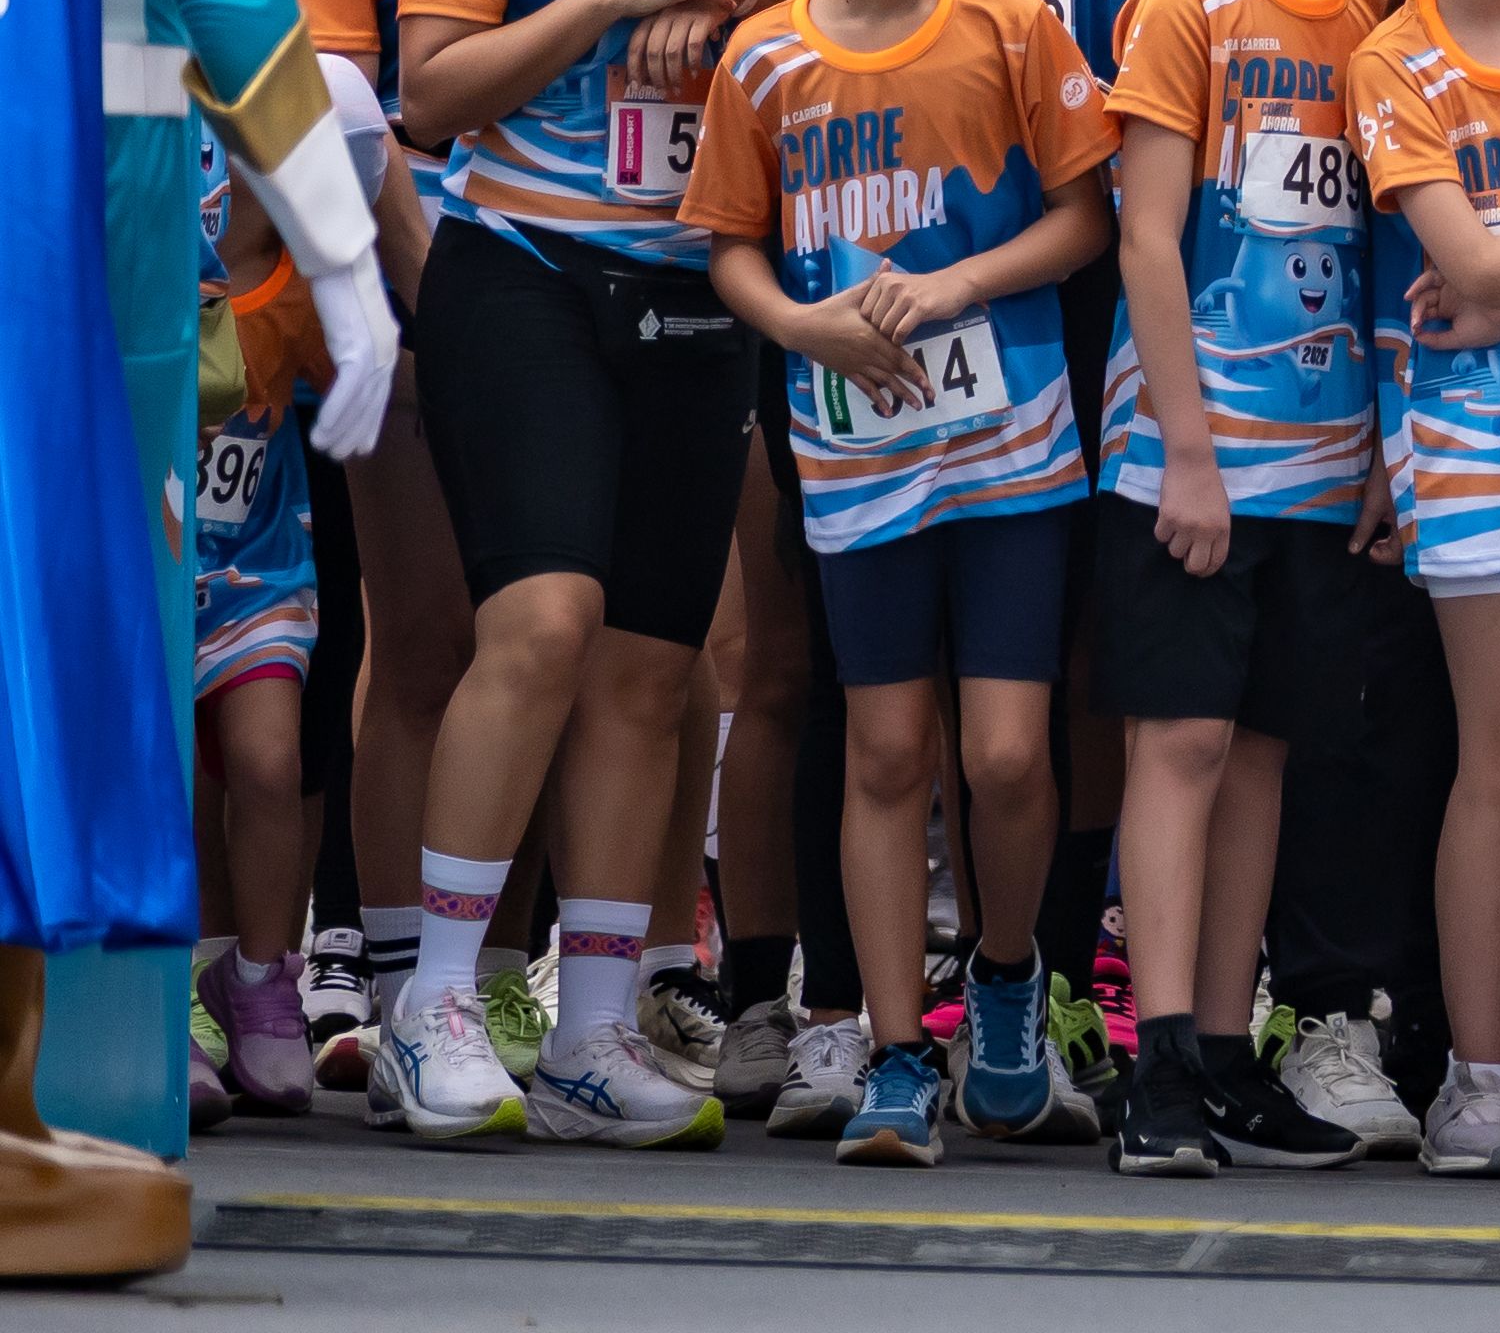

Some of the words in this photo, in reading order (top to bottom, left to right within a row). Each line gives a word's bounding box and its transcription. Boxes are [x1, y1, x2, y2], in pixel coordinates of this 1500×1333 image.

[1240, 38, 1282, 52] CARRERA
[791, 101, 834, 123] CARRERA
[1259, 116, 1300, 133] AHORRA
[625, 114, 636, 170] IDEMSPORT
[781, 106, 905, 195] CORRE
[793, 166, 948, 258] AHORRA
